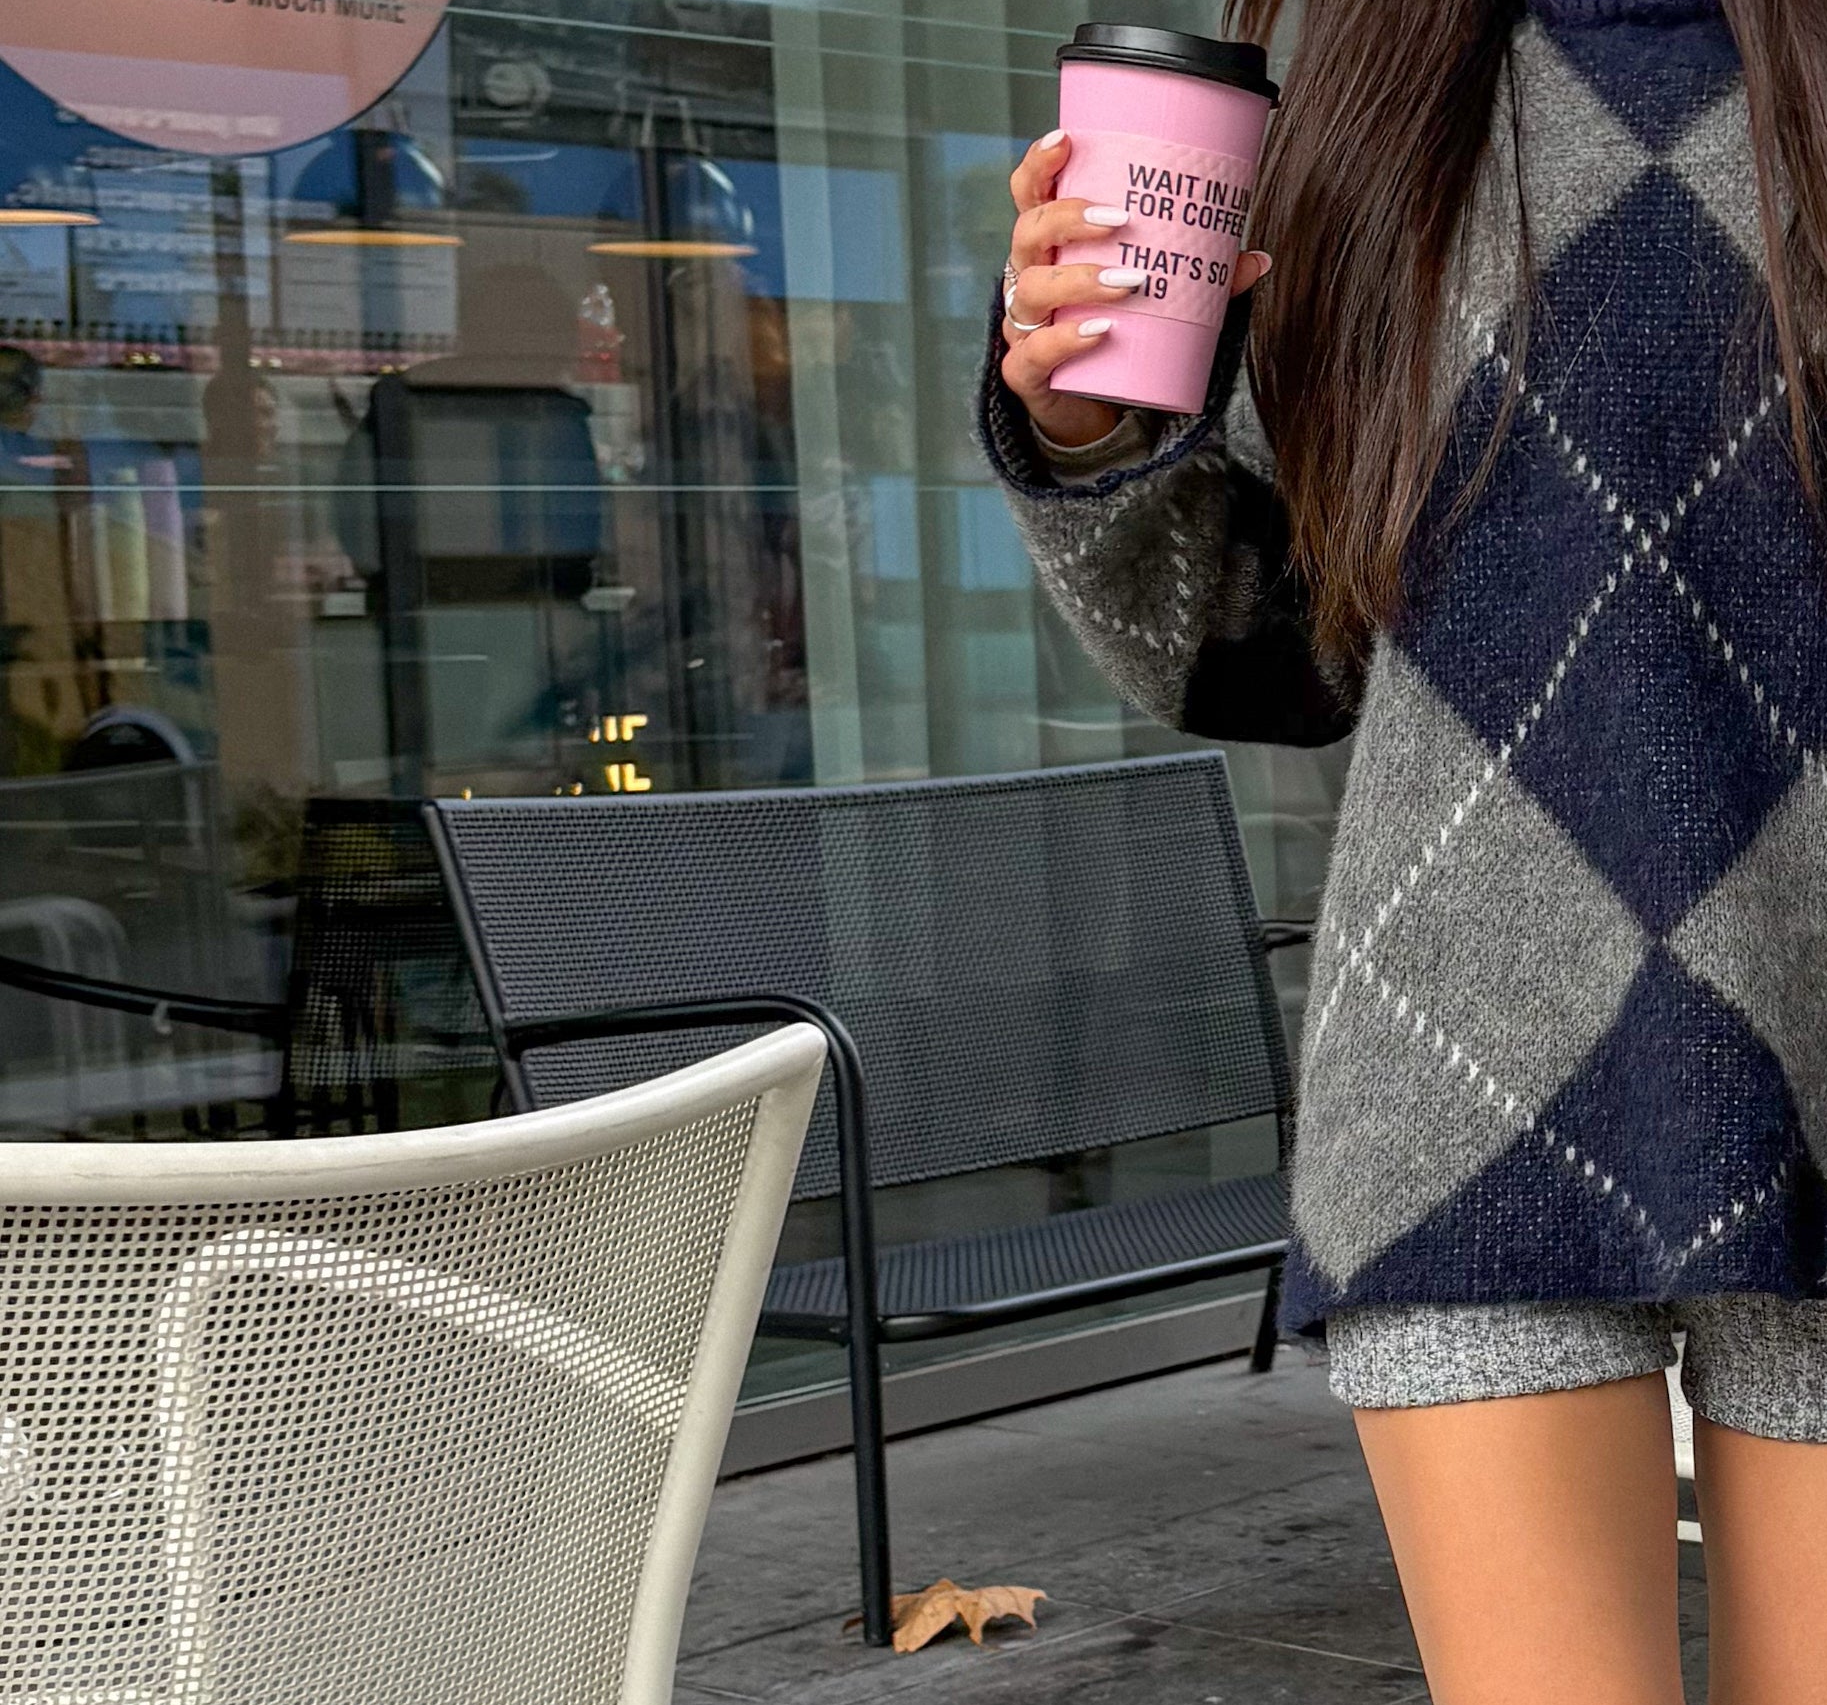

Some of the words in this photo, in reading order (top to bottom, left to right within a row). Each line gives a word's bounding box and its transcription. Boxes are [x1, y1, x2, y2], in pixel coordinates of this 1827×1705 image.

[1124, 189, 1175, 222] FOR
[1128, 162, 1201, 199] WAIT
[1203, 179, 1229, 207] IN
[1230, 185, 1251, 214] LIN
[1117, 241, 1204, 281] THAT'S
[1207, 261, 1229, 287] SO
[1130, 273, 1168, 300] 19
